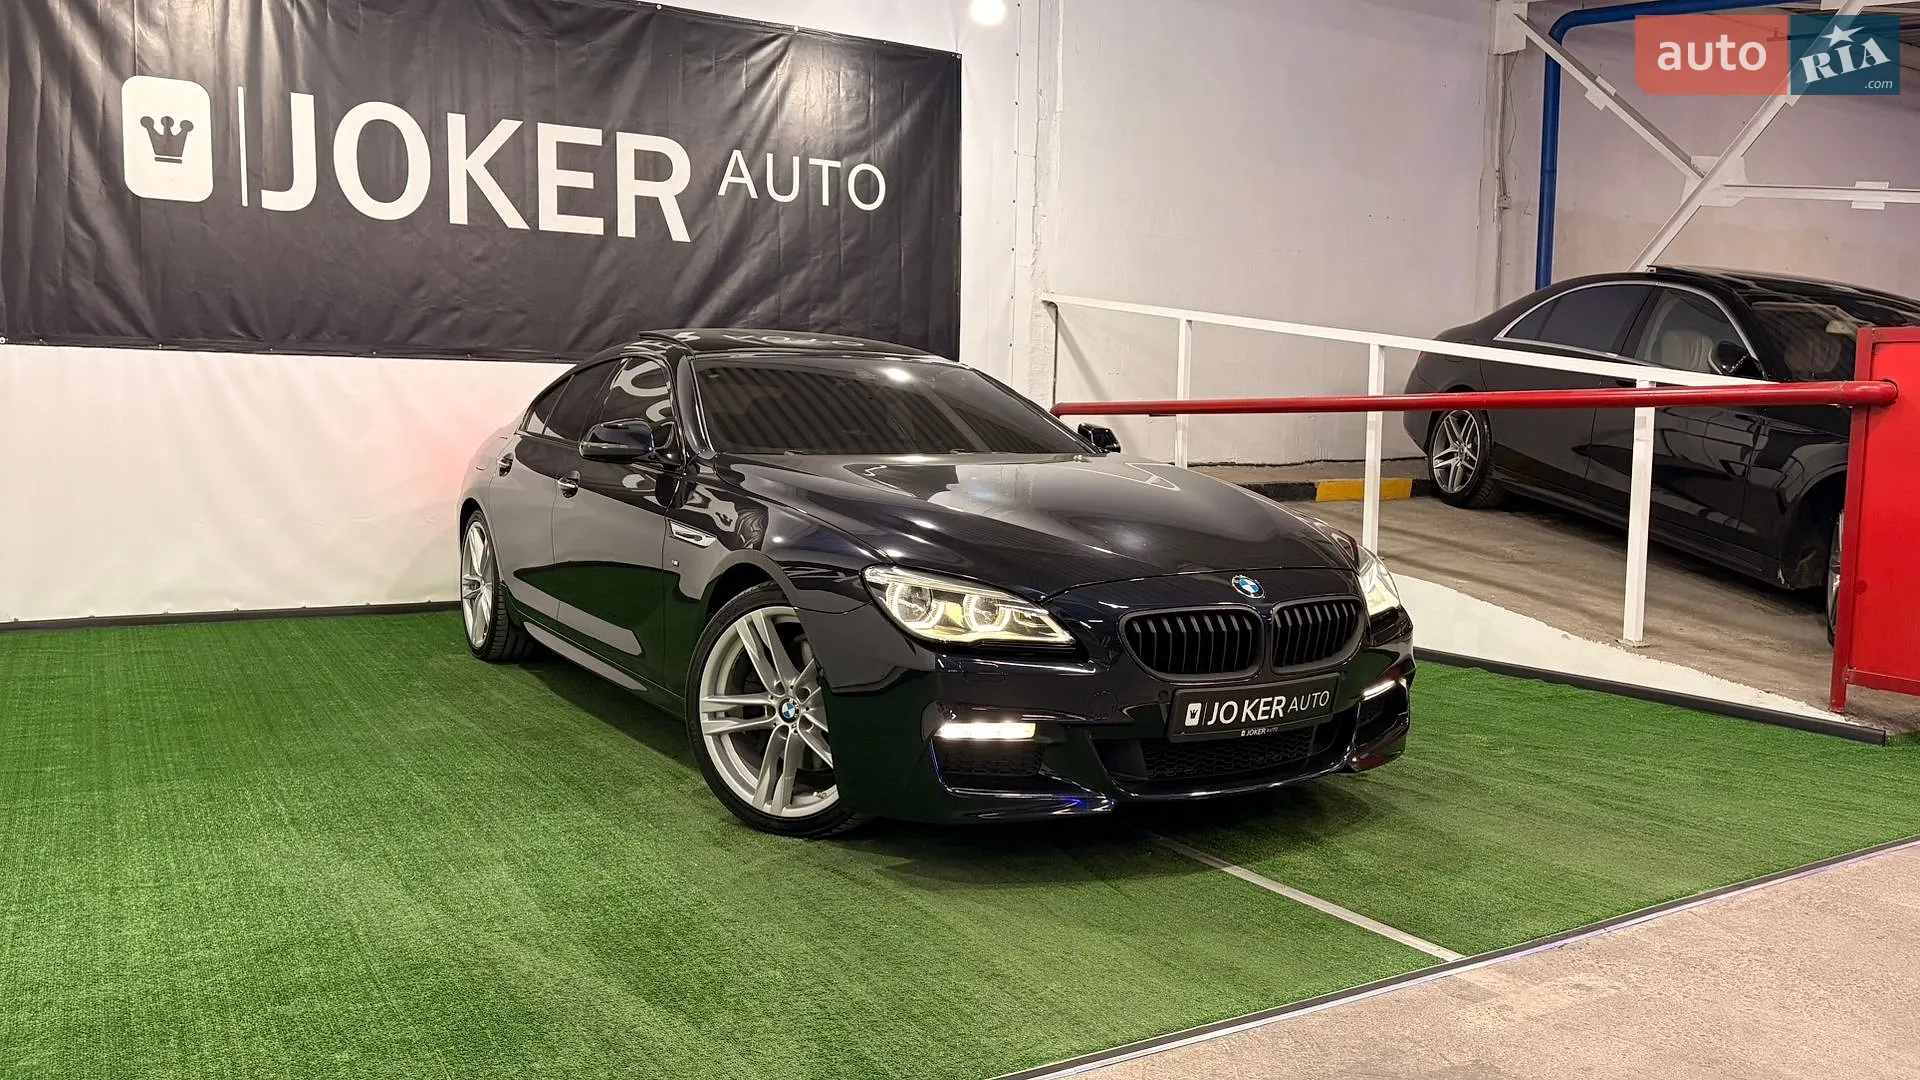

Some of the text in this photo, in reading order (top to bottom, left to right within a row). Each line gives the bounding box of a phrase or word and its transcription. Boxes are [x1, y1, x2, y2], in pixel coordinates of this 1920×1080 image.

[260, 91, 887, 243] JOKER AUTO
[1287, 690, 1330, 713] AUTO
[1246, 727, 1266, 736] JOKER
